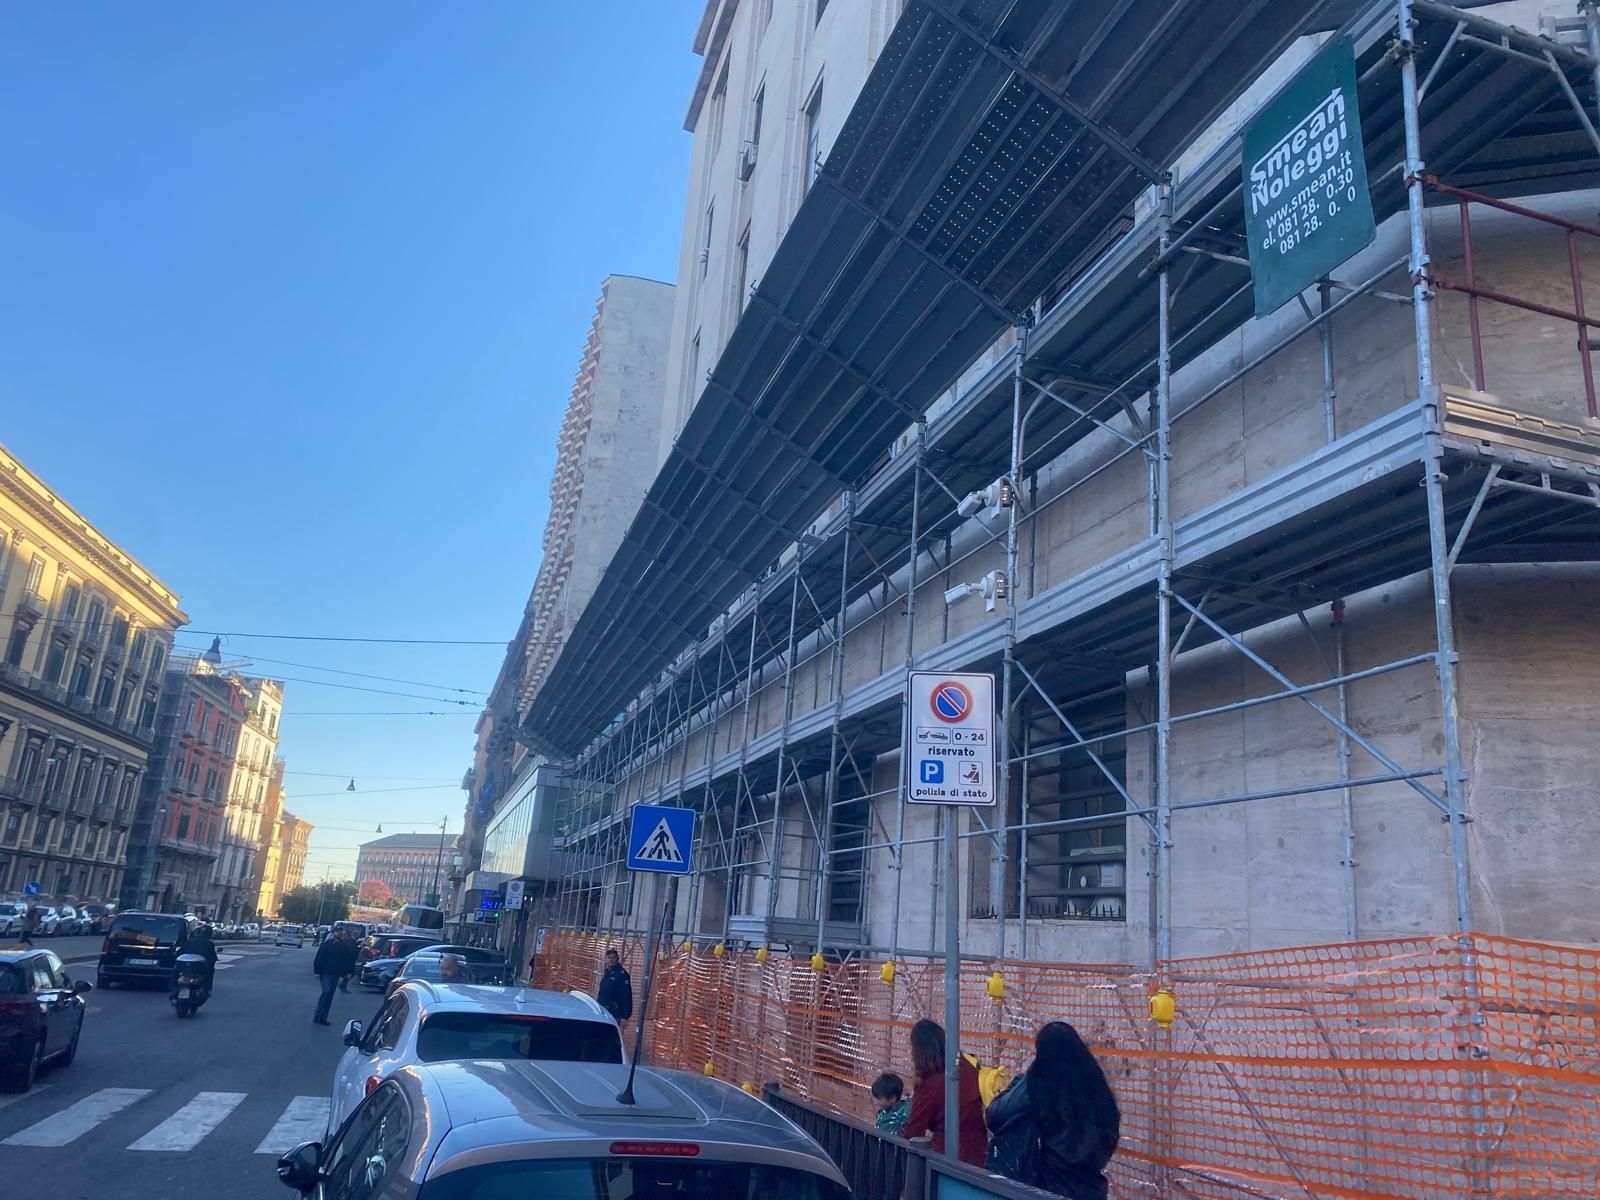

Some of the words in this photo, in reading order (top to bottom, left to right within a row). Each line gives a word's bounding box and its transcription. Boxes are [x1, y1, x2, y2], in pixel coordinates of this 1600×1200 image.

[1251, 114, 1348, 215] Noleggi
[1263, 230, 1276, 250] el.
[1277, 212, 1298, 238] 081
[1300, 198, 1320, 220] 28.
[1326, 168, 1353, 199] 0.30
[1280, 229, 1300, 254] 081
[1303, 215, 1322, 238] 28.
[1347, 186, 1356, 202] 0
[971, 733, 984, 741] 24
[928, 746, 975, 757] riservato
[925, 762, 939, 781] P
[916, 787, 946, 797] polizia
[950, 788, 959, 797] di
[963, 789, 988, 798] stato
[476, 911, 484, 920] P
